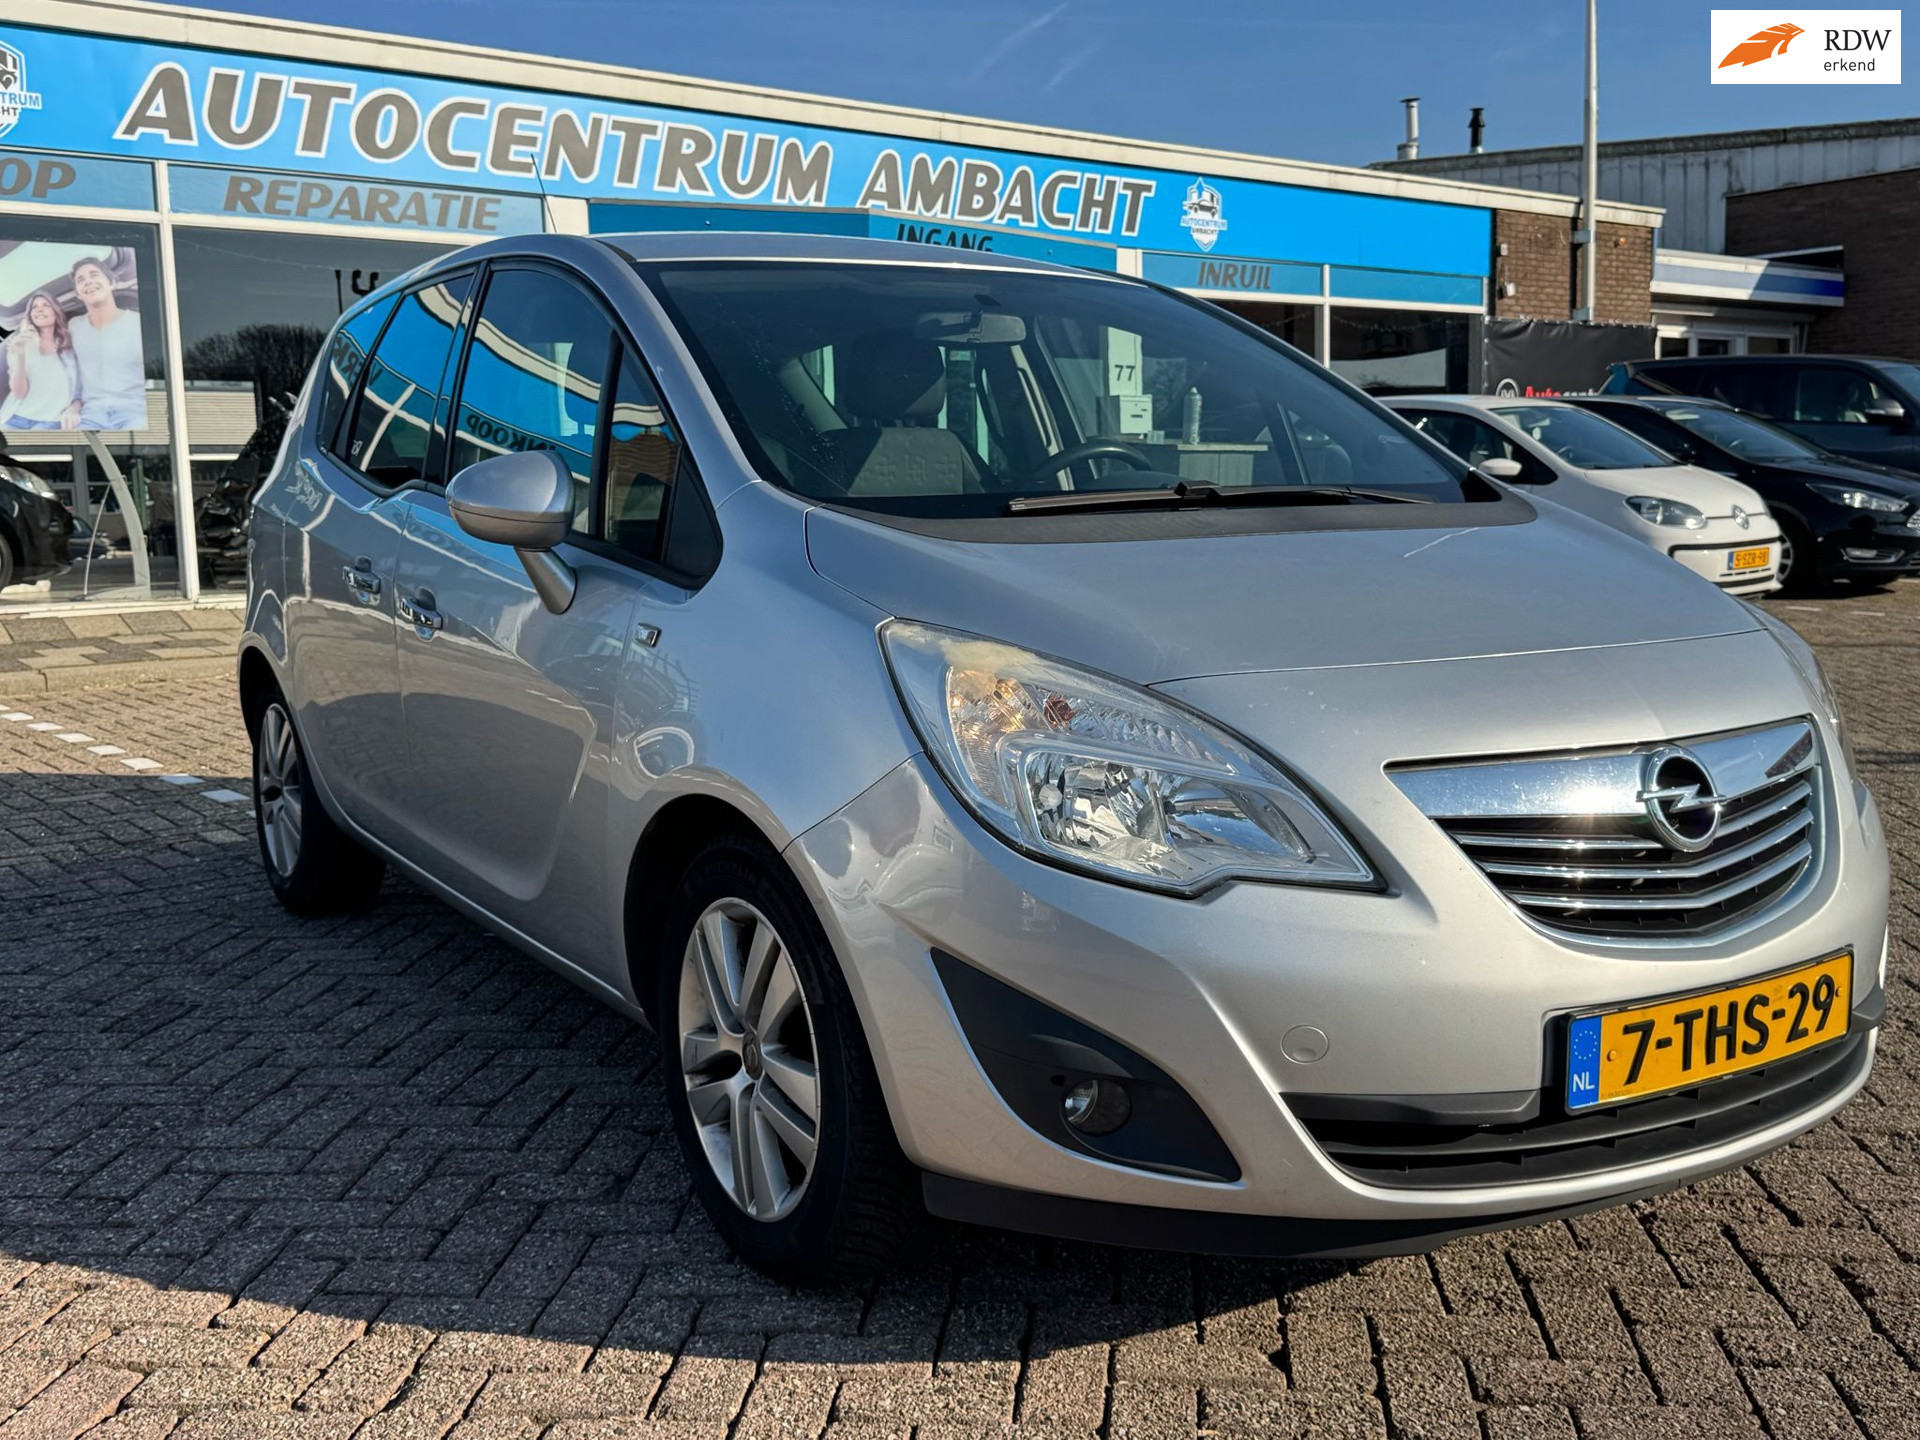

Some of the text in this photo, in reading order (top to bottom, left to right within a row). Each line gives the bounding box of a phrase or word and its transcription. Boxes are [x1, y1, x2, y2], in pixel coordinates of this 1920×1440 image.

[114, 62, 1156, 238] AUTOCENTRUM AMBACHT
[223, 176, 501, 231] REPARATIE
[897, 223, 994, 252] INGANG
[1197, 261, 1271, 289] INRUIL
[1114, 364, 1135, 381] 77
[1622, 973, 1836, 1087] 7-THS-29
[1572, 1071, 1596, 1093] NL
